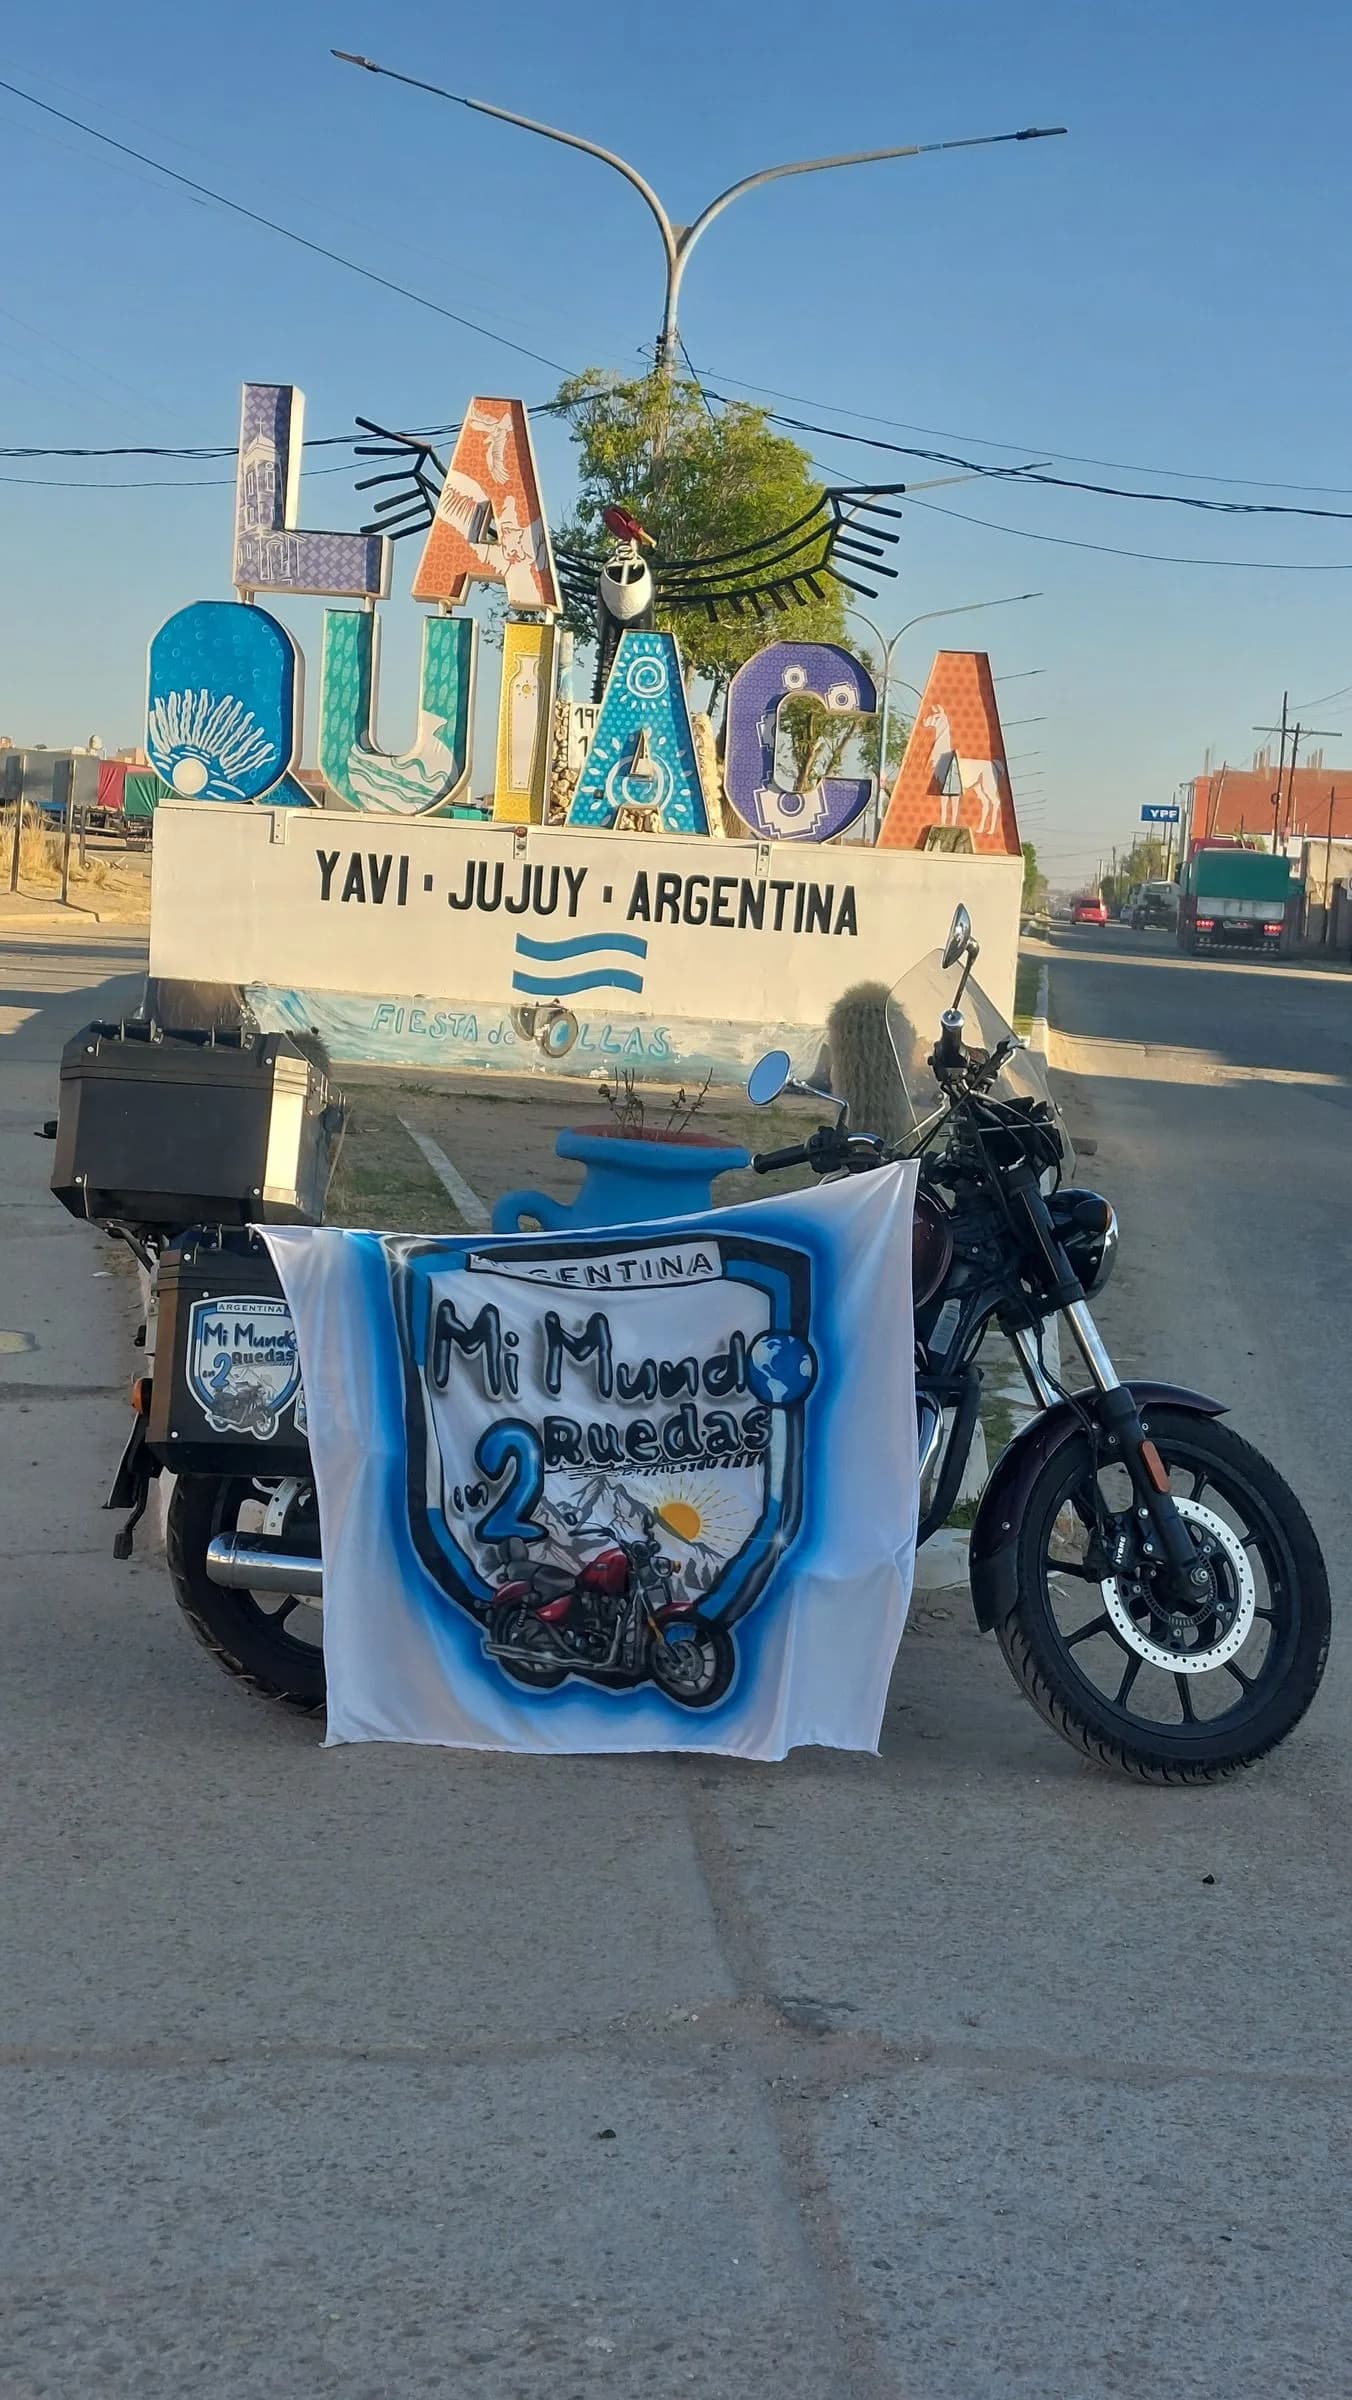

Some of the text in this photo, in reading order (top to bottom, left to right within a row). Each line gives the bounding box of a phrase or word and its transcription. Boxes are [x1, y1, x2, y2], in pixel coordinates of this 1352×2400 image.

[233, 382, 563, 614] LA
[145, 600, 1023, 857] QUIACA
[1150, 809, 1177, 818] YPF
[316, 850, 858, 936] YAVI JUJUY ARGENTINA
[371, 1003, 479, 1042] FIESTA
[468, 1252, 714, 1285] ENTINA
[218, 1304, 283, 1313] ARGENTINA
[203, 1322, 229, 1347] Mi
[433, 1298, 520, 1396] Mi
[210, 1352, 232, 1388] 2
[232, 1348, 295, 1365] Ruedas
[475, 1417, 549, 1543] 2
[543, 1402, 773, 1466] Ruedas
